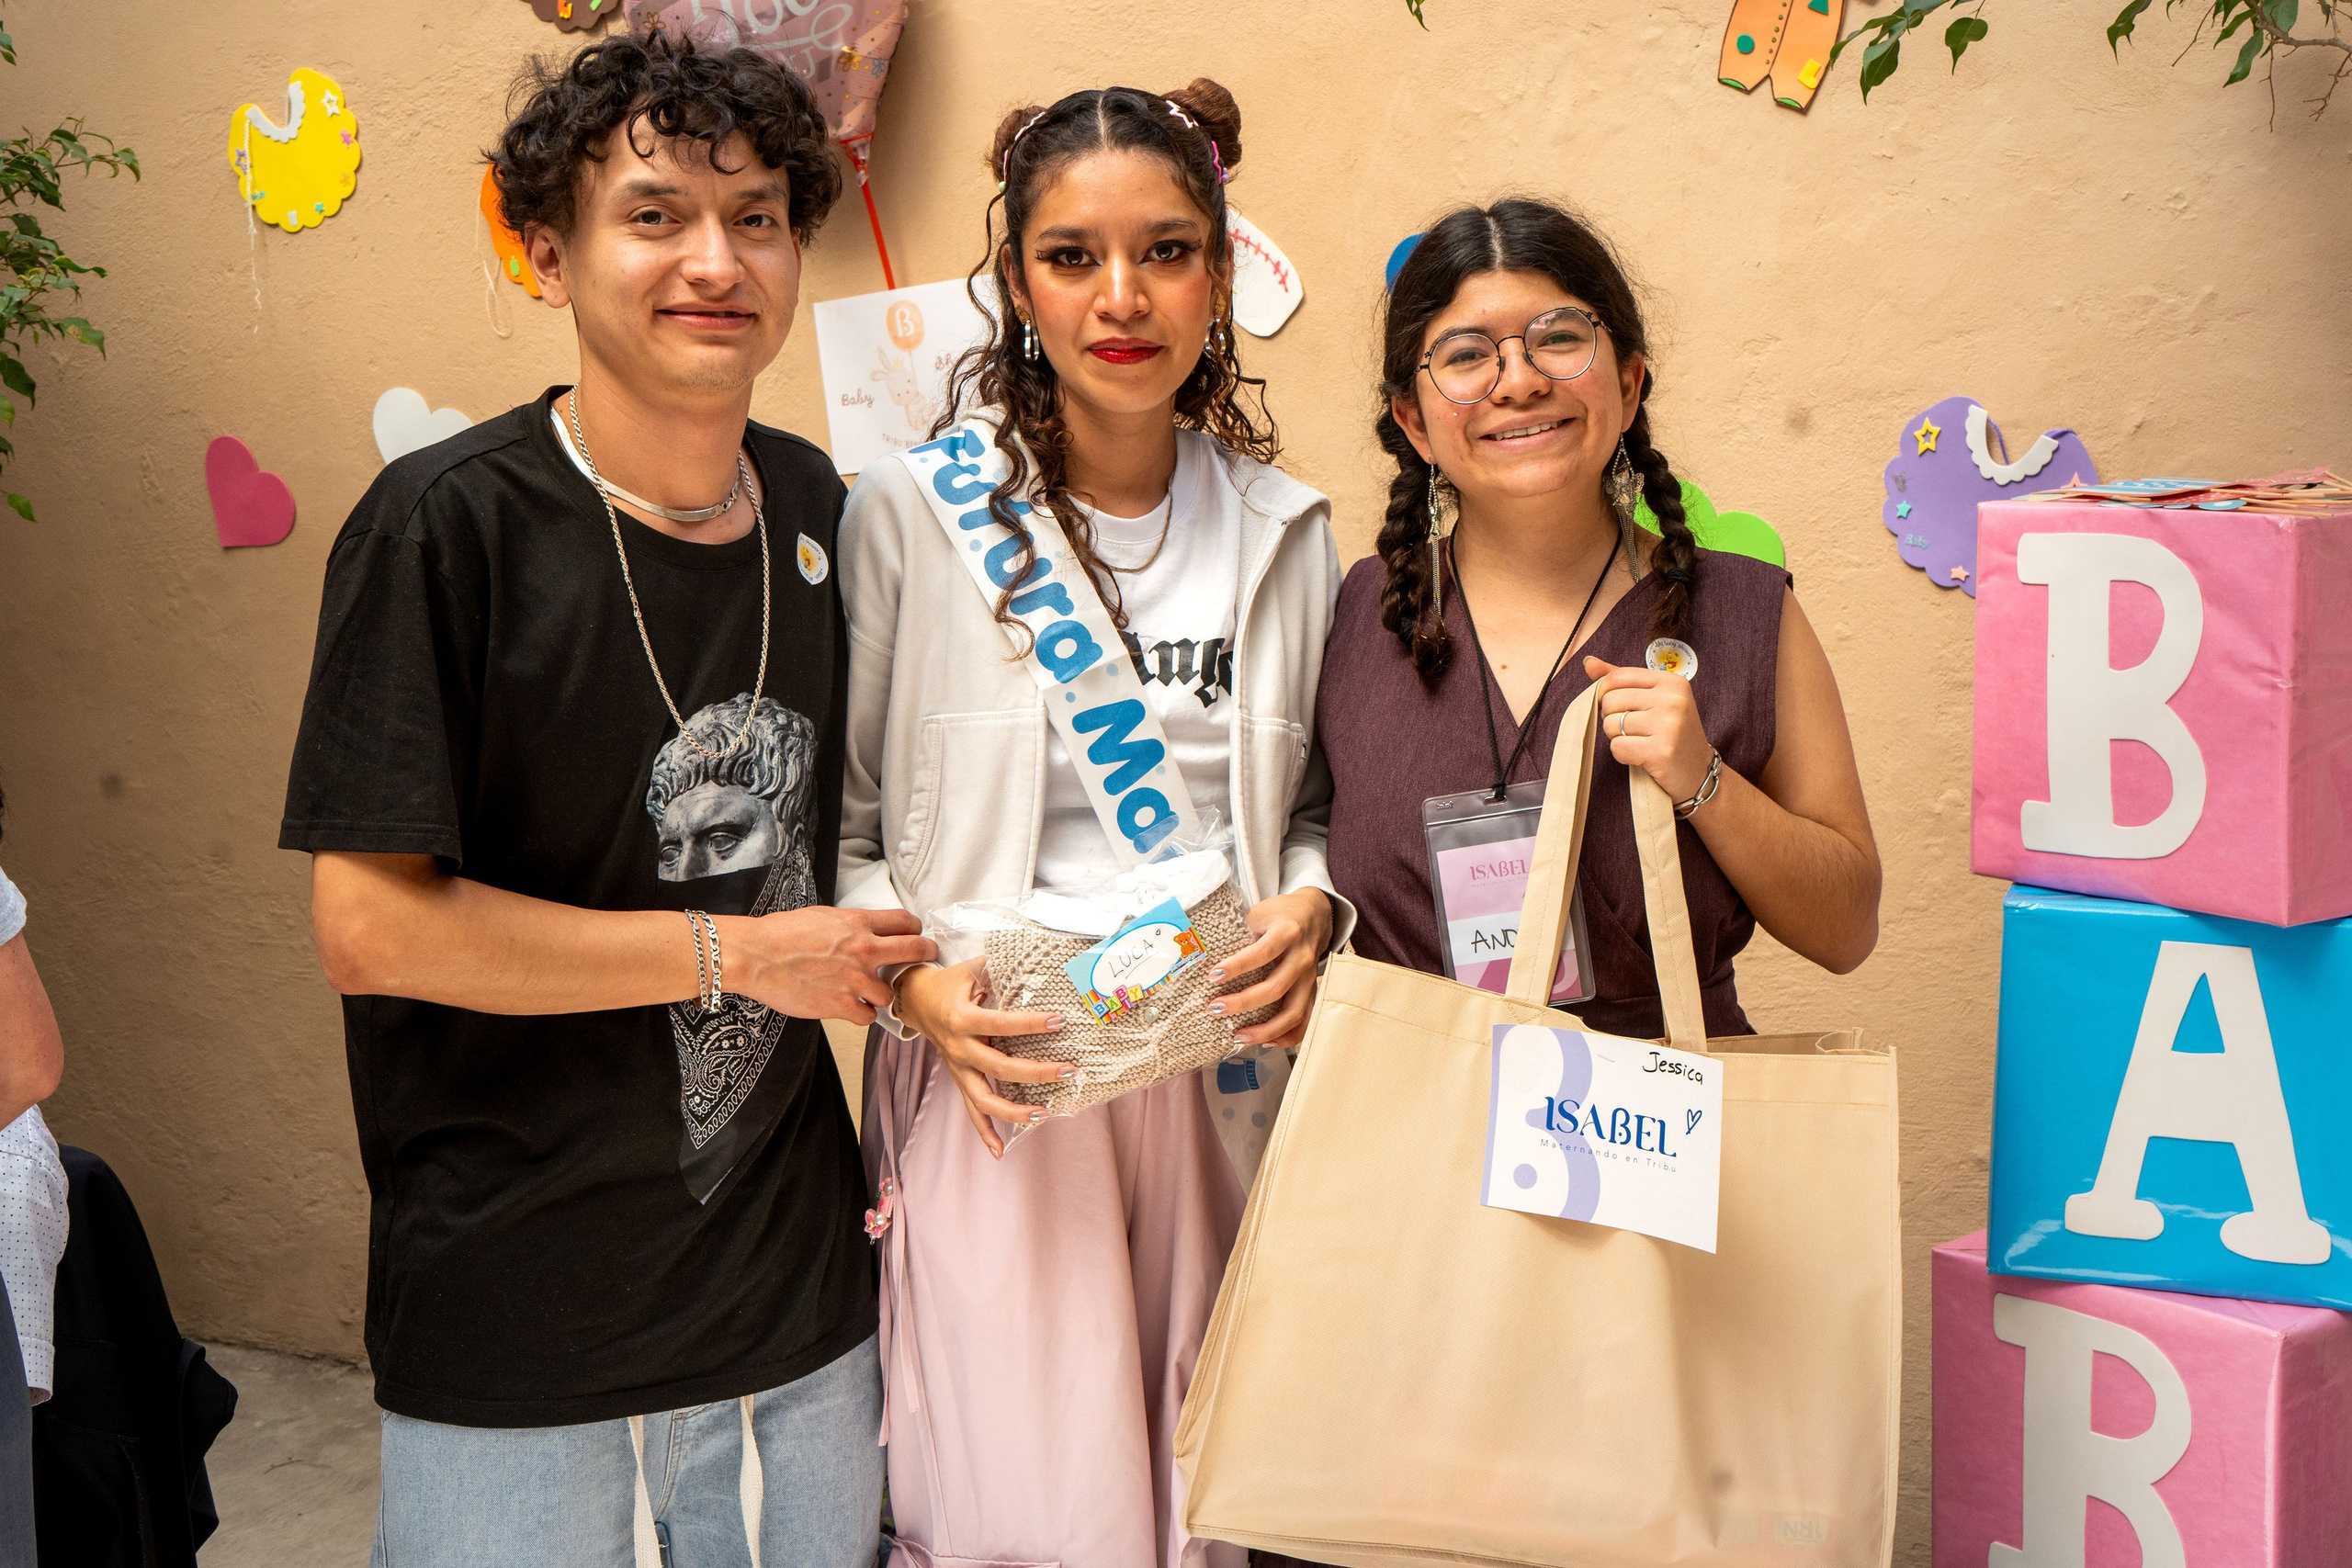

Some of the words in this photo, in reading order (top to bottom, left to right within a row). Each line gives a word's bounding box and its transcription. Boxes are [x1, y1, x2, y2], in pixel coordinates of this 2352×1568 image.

[841, 388, 875, 408] Baby
[882, 434, 903, 448] TRIBU
[2018, 533, 2207, 860] B
[1470, 858, 1529, 881] ISABEL
[1471, 929, 1518, 953] AND
[1108, 939, 1155, 978] LUCA
[1094, 987, 1141, 1017] BABY
[1642, 1051, 1703, 1085] Jessica
[2064, 940, 2332, 1266] A
[1544, 1096, 1678, 1158] ISABEL
[1540, 1138, 1618, 1160] Maternando
[1625, 1155, 1638, 1164] en
[1645, 1157, 1678, 1173] Tribu
[1988, 1293, 2192, 1568] B
